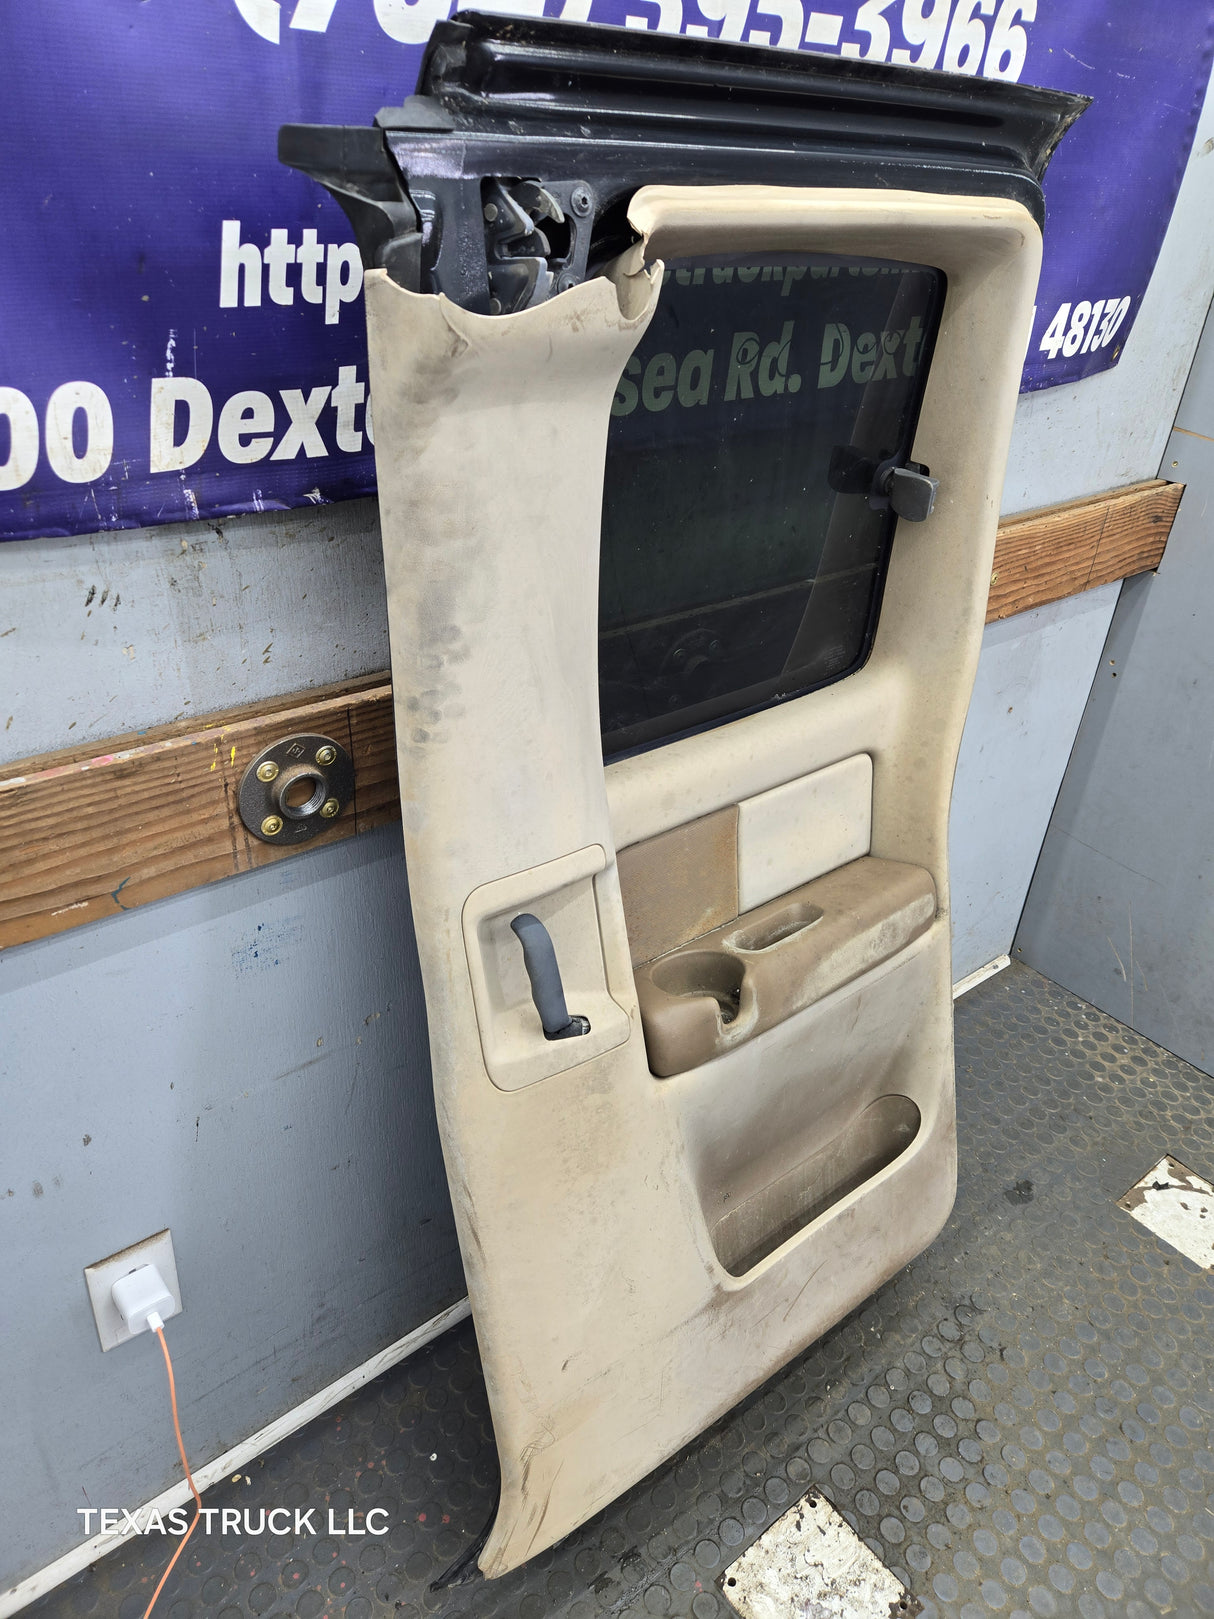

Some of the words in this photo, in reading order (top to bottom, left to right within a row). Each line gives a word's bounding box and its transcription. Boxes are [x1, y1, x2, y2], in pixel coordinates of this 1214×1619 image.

[219, 220, 364, 325] http
[150, 366, 374, 474] Dext
[724, 320, 802, 401] Rd.
[1039, 295, 1131, 360] 48130
